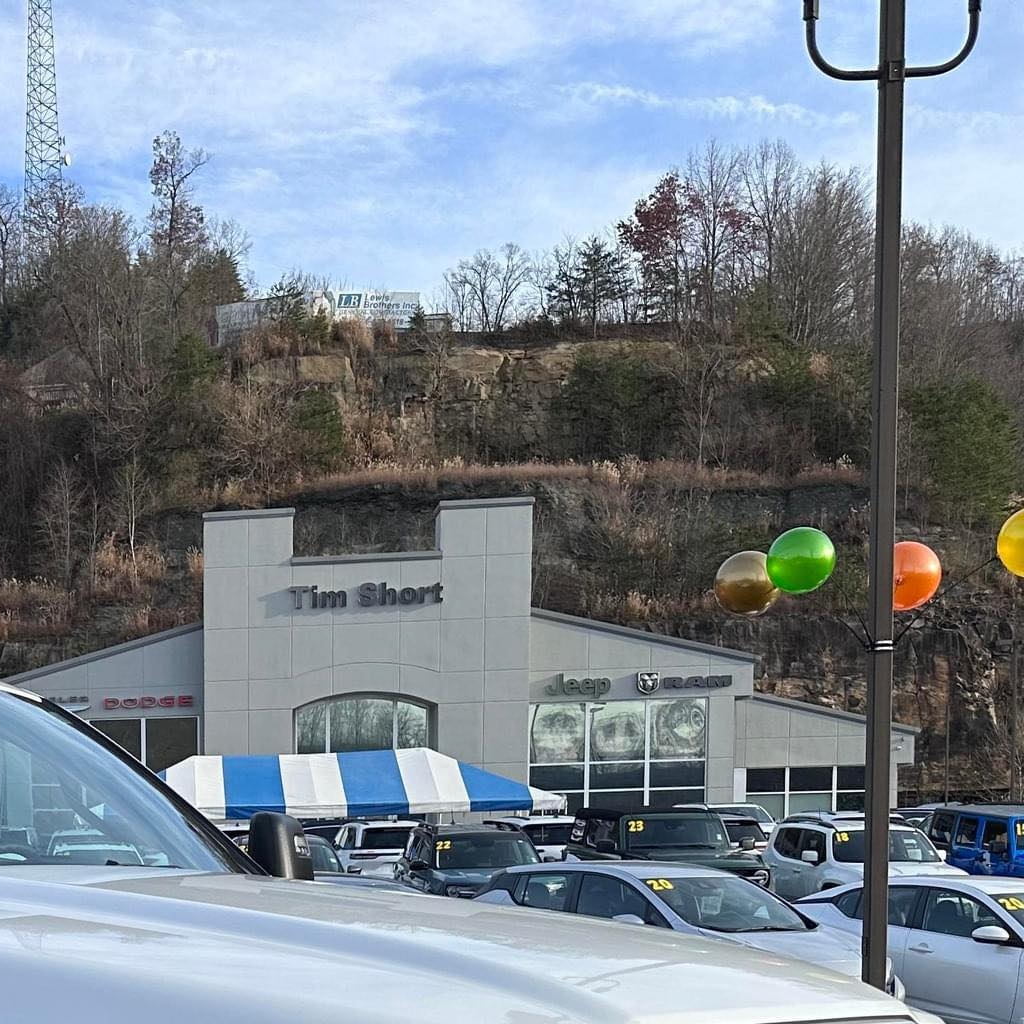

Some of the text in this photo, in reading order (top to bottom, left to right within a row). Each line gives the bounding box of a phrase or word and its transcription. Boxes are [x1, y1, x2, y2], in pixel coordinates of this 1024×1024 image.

[364, 293, 390, 302] Lewis
[363, 301, 401, 310] Brothers
[288, 581, 444, 610] Tim Short
[544, 673, 612, 698] Jeep
[663, 674, 733, 689] RAM
[103, 695, 195, 710] DODGE
[627, 820, 645, 832] 23
[1016, 823, 1024, 837] 1
[835, 832, 850, 842] 18
[435, 840, 452, 850] 22
[647, 878, 674, 891] 20
[998, 897, 1024, 911] 20
